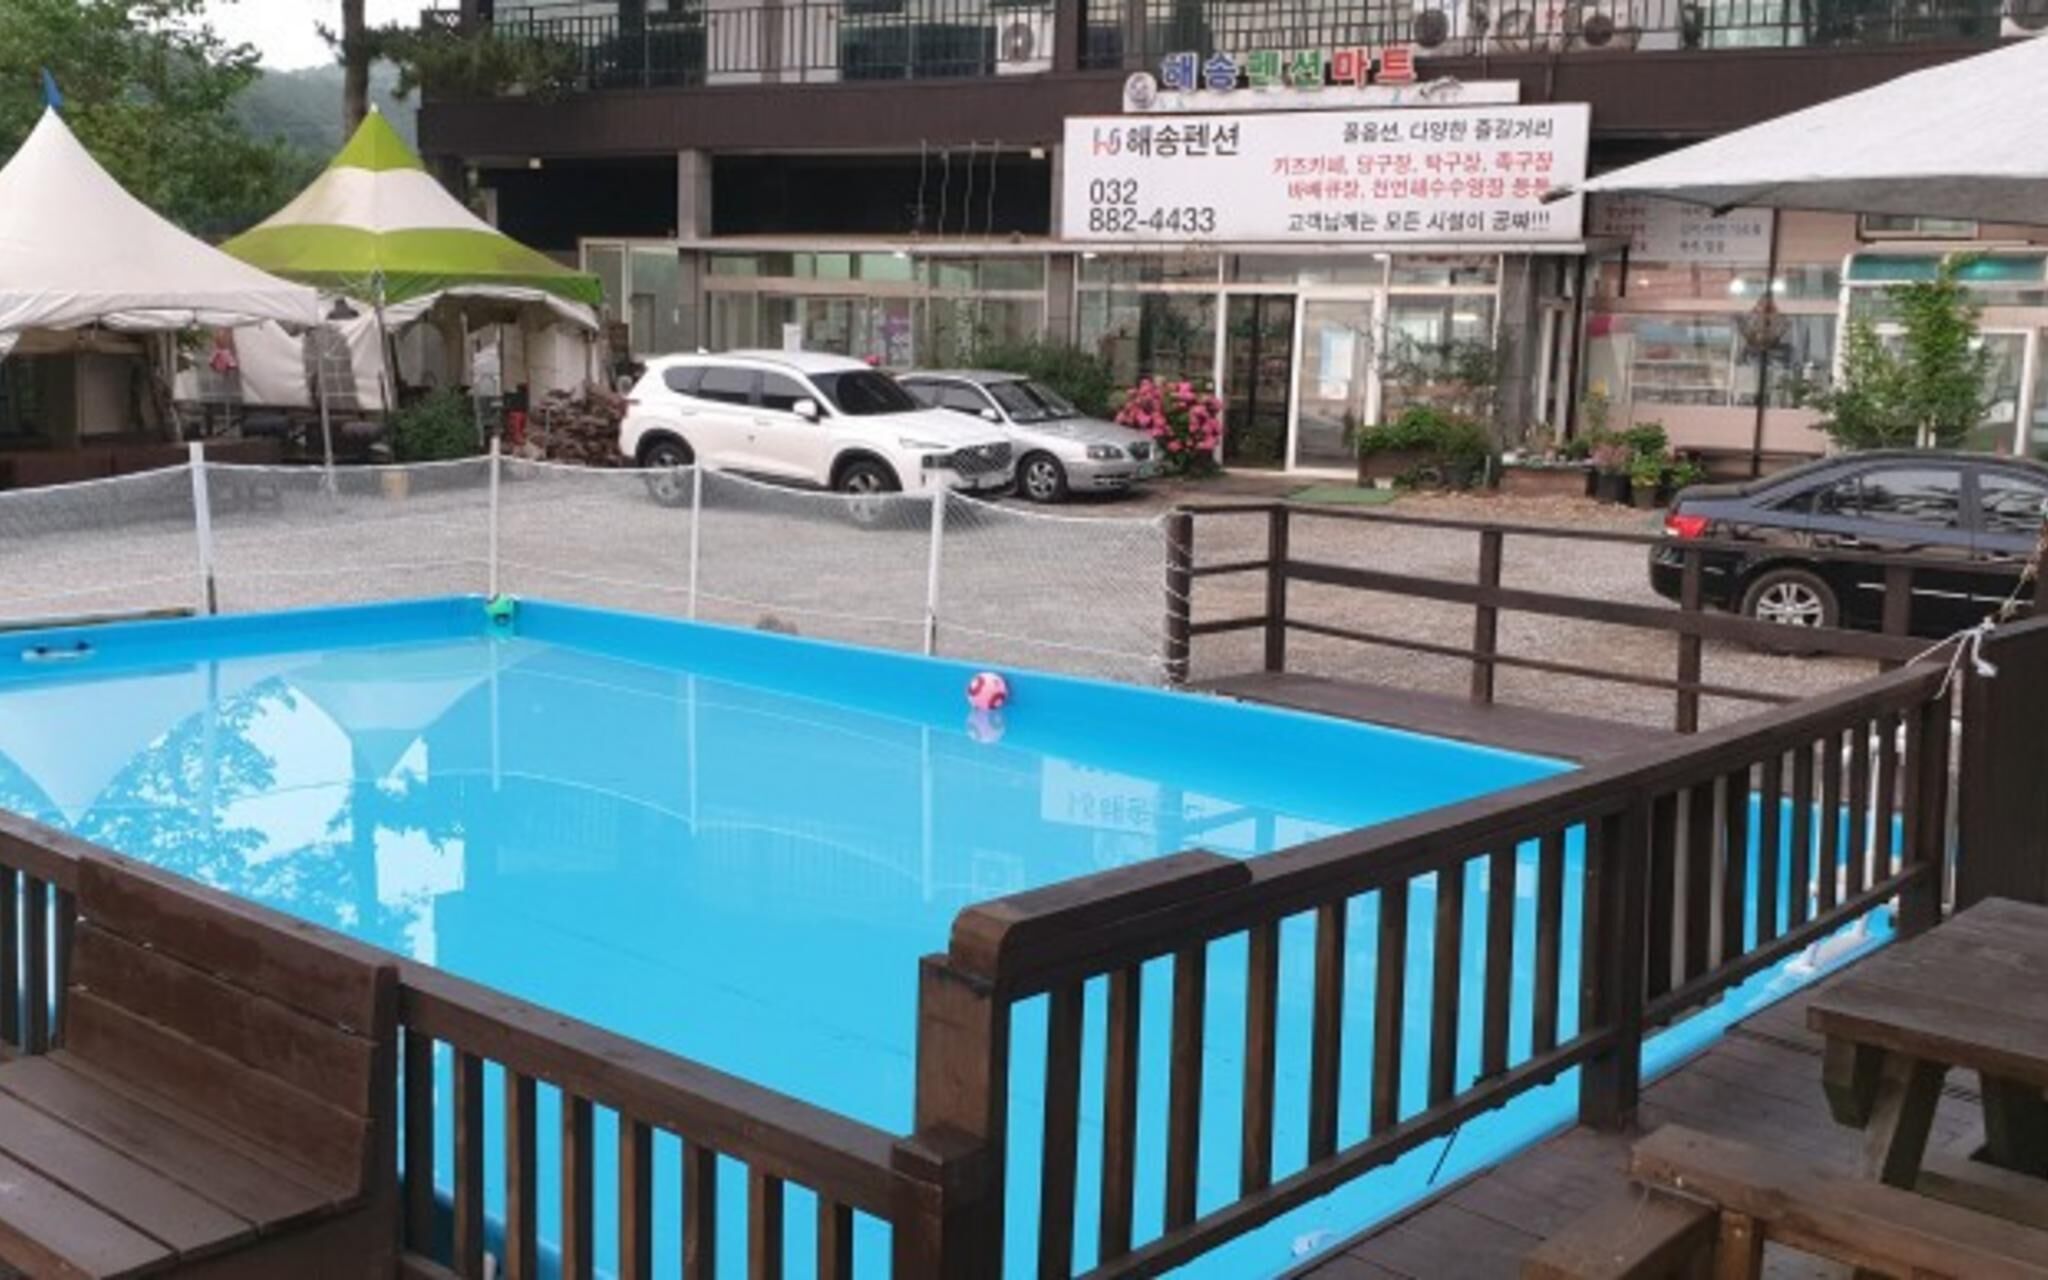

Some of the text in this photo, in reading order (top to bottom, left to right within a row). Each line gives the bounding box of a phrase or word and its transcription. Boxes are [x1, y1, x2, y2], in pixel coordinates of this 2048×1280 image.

[1125, 122, 1240, 157] 해송펜션
[1410, 119, 1467, 142] 다양한
[1475, 117, 1553, 141] 즐길거리
[1089, 178, 1138, 205] 032
[1089, 207, 1216, 232] 882-4433
[1287, 210, 1551, 232] 고객님께는 모든 시설이 공짜!!!
